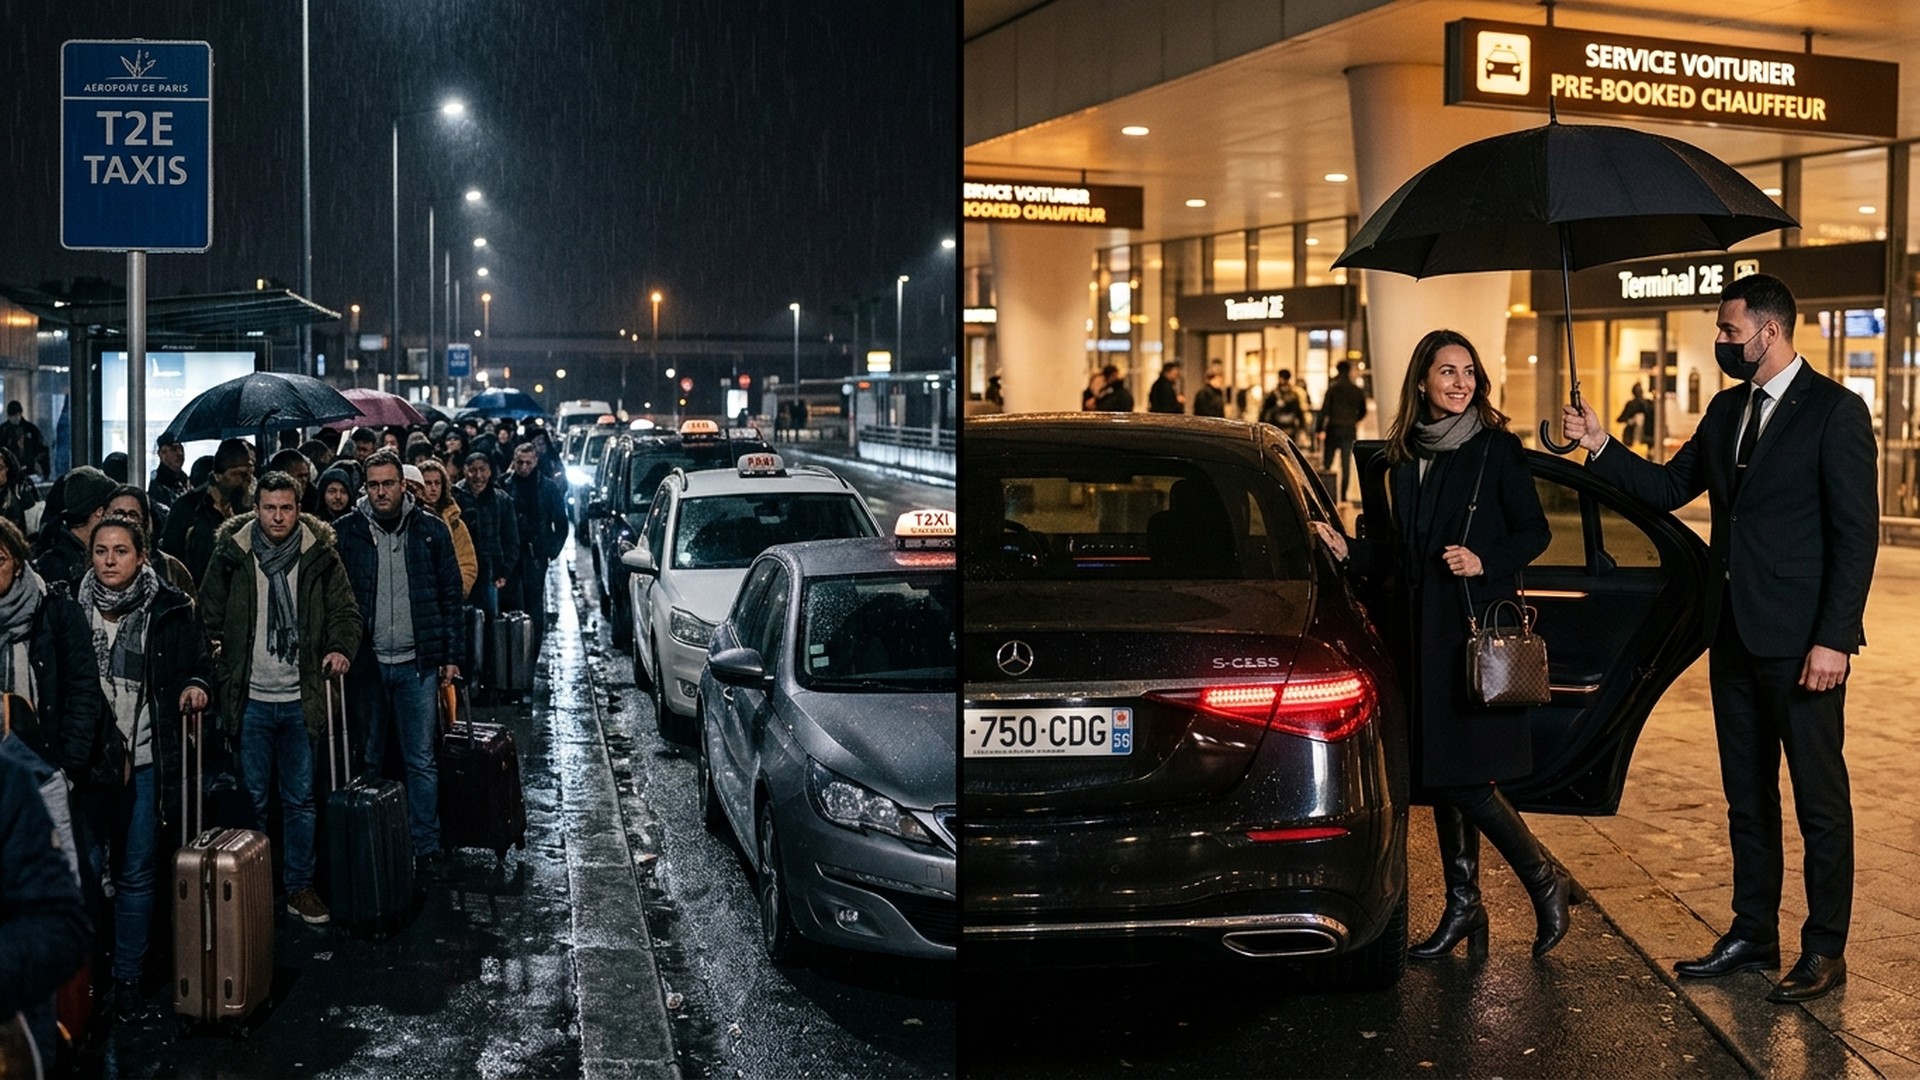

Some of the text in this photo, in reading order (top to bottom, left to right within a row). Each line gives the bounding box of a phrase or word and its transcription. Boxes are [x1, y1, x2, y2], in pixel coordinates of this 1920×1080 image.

[1585, 43, 1796, 86] SERVICE VOITURIER
[158, 83, 189, 93] PARIS
[1551, 73, 1827, 121] PRE-BOOKED CHAUFFEUR
[96, 111, 174, 146] T2E
[83, 155, 188, 185] TAXIS
[1619, 264, 1724, 299] Terminal 2E
[914, 512, 949, 527] T2XI
[1212, 657, 1280, 669] S-CESS
